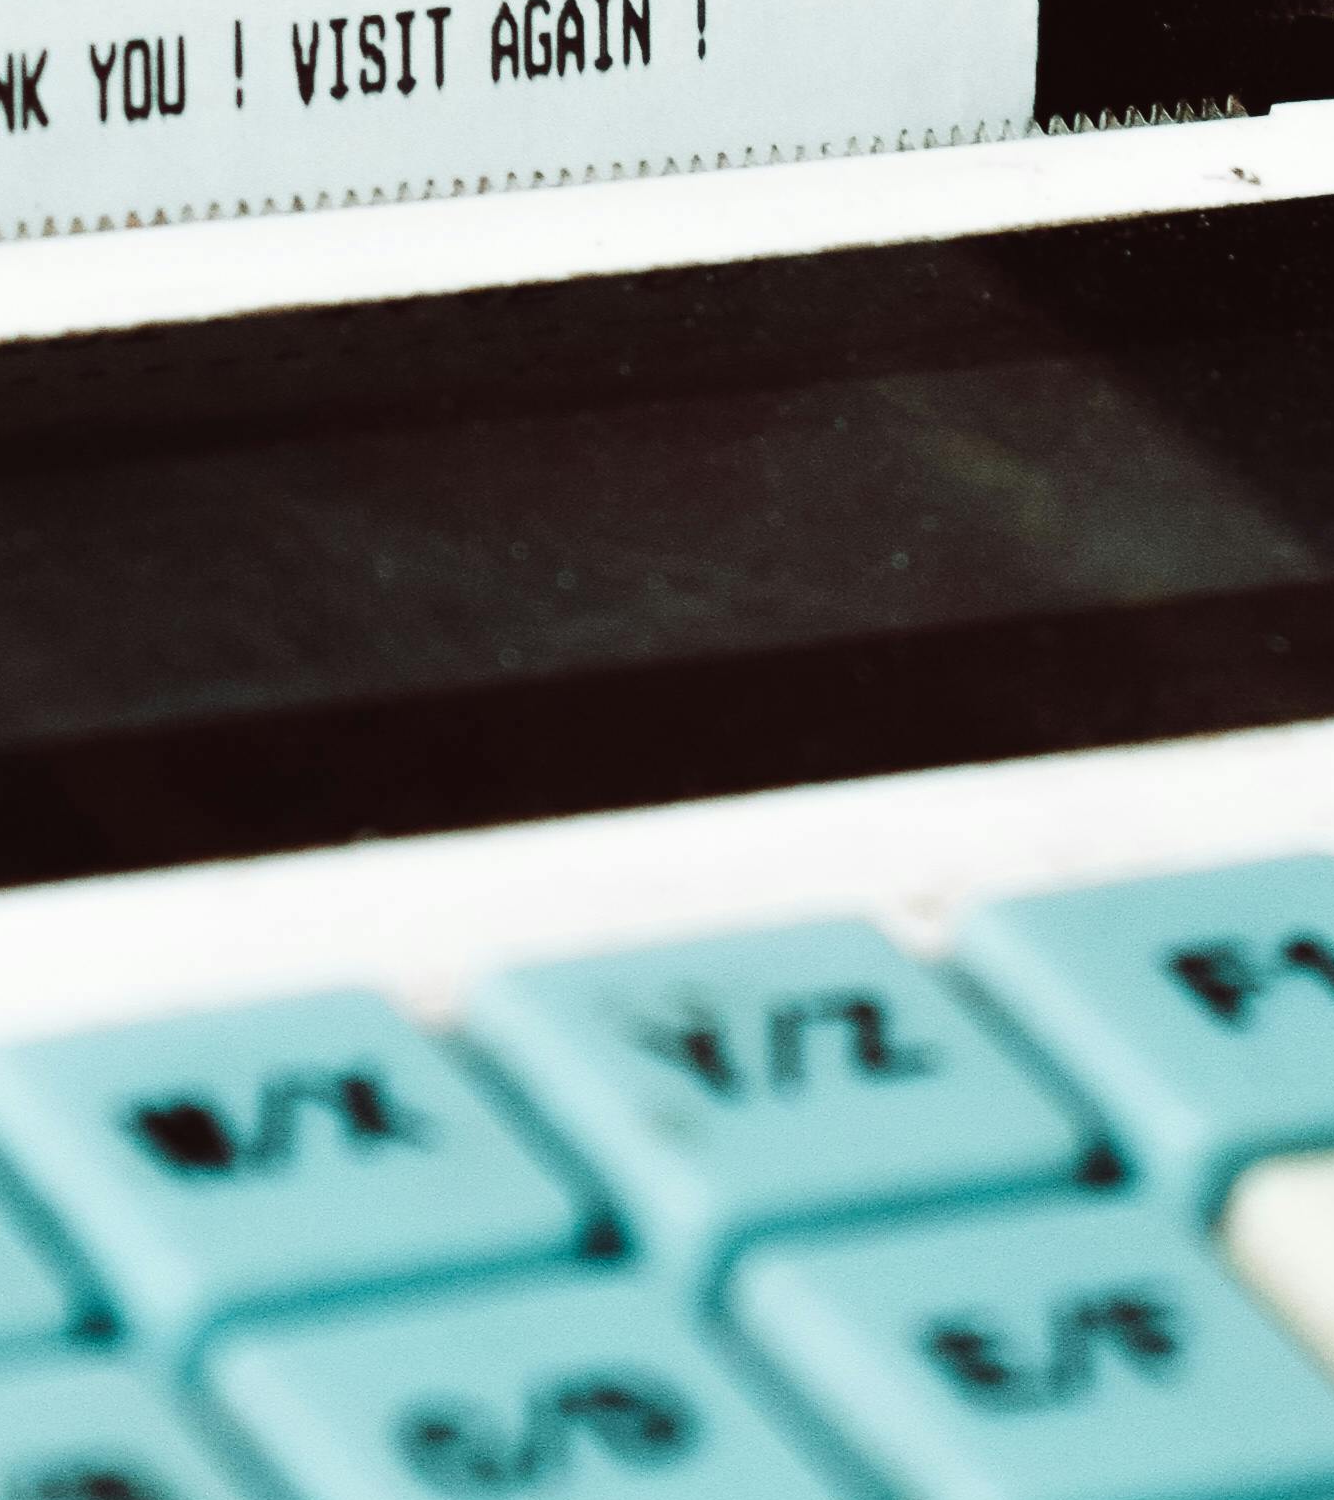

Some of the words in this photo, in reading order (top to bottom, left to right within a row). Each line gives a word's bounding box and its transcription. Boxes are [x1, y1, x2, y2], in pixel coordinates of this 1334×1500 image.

[89, 34, 187, 125] YOU
[291, 6, 452, 107] VISIT
[644, 991, 930, 1099] Y/Z
[922, 1288, 1182, 1410] E/F
